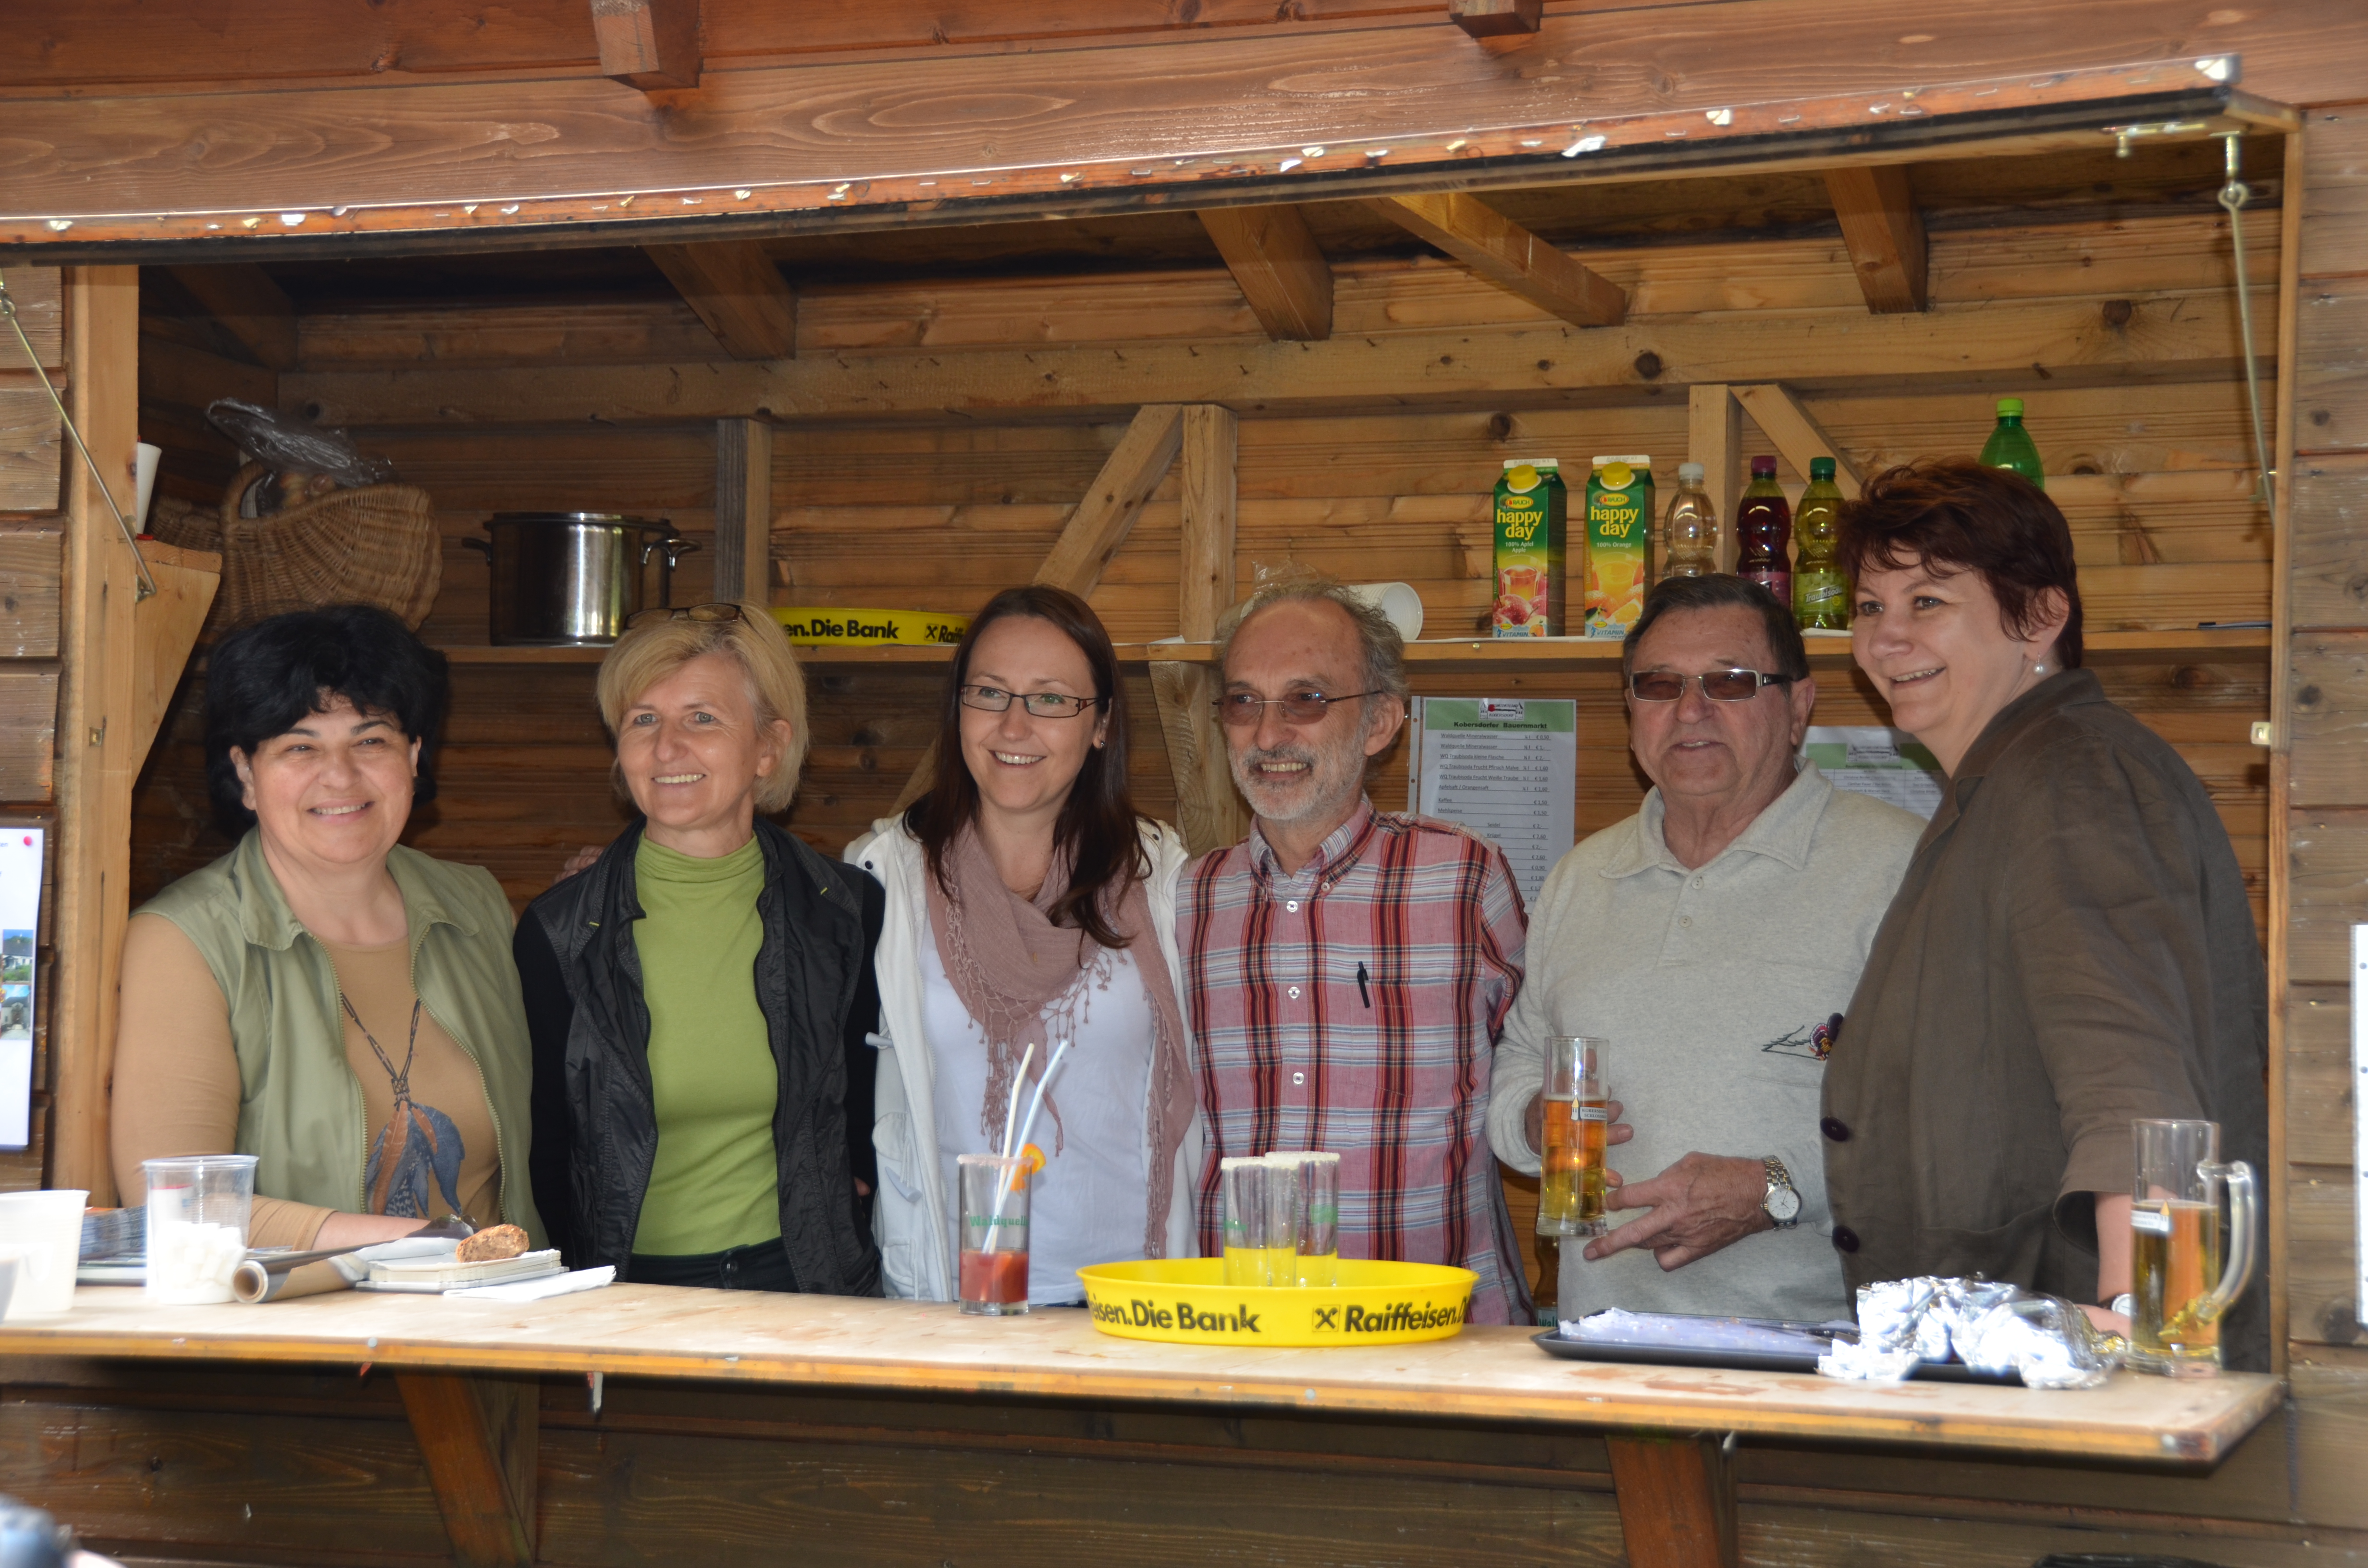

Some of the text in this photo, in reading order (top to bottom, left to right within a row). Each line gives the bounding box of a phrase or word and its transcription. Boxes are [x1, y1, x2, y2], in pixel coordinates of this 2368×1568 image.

[1497, 508, 1543, 527] happy
[1591, 506, 1639, 524] happy
[1505, 523, 1535, 541] day
[1600, 521, 1630, 538] day
[847, 620, 899, 639] Bank
[1176, 1302, 1261, 1333] Bank
[1344, 1296, 1470, 1332] Raiffeisen.D
